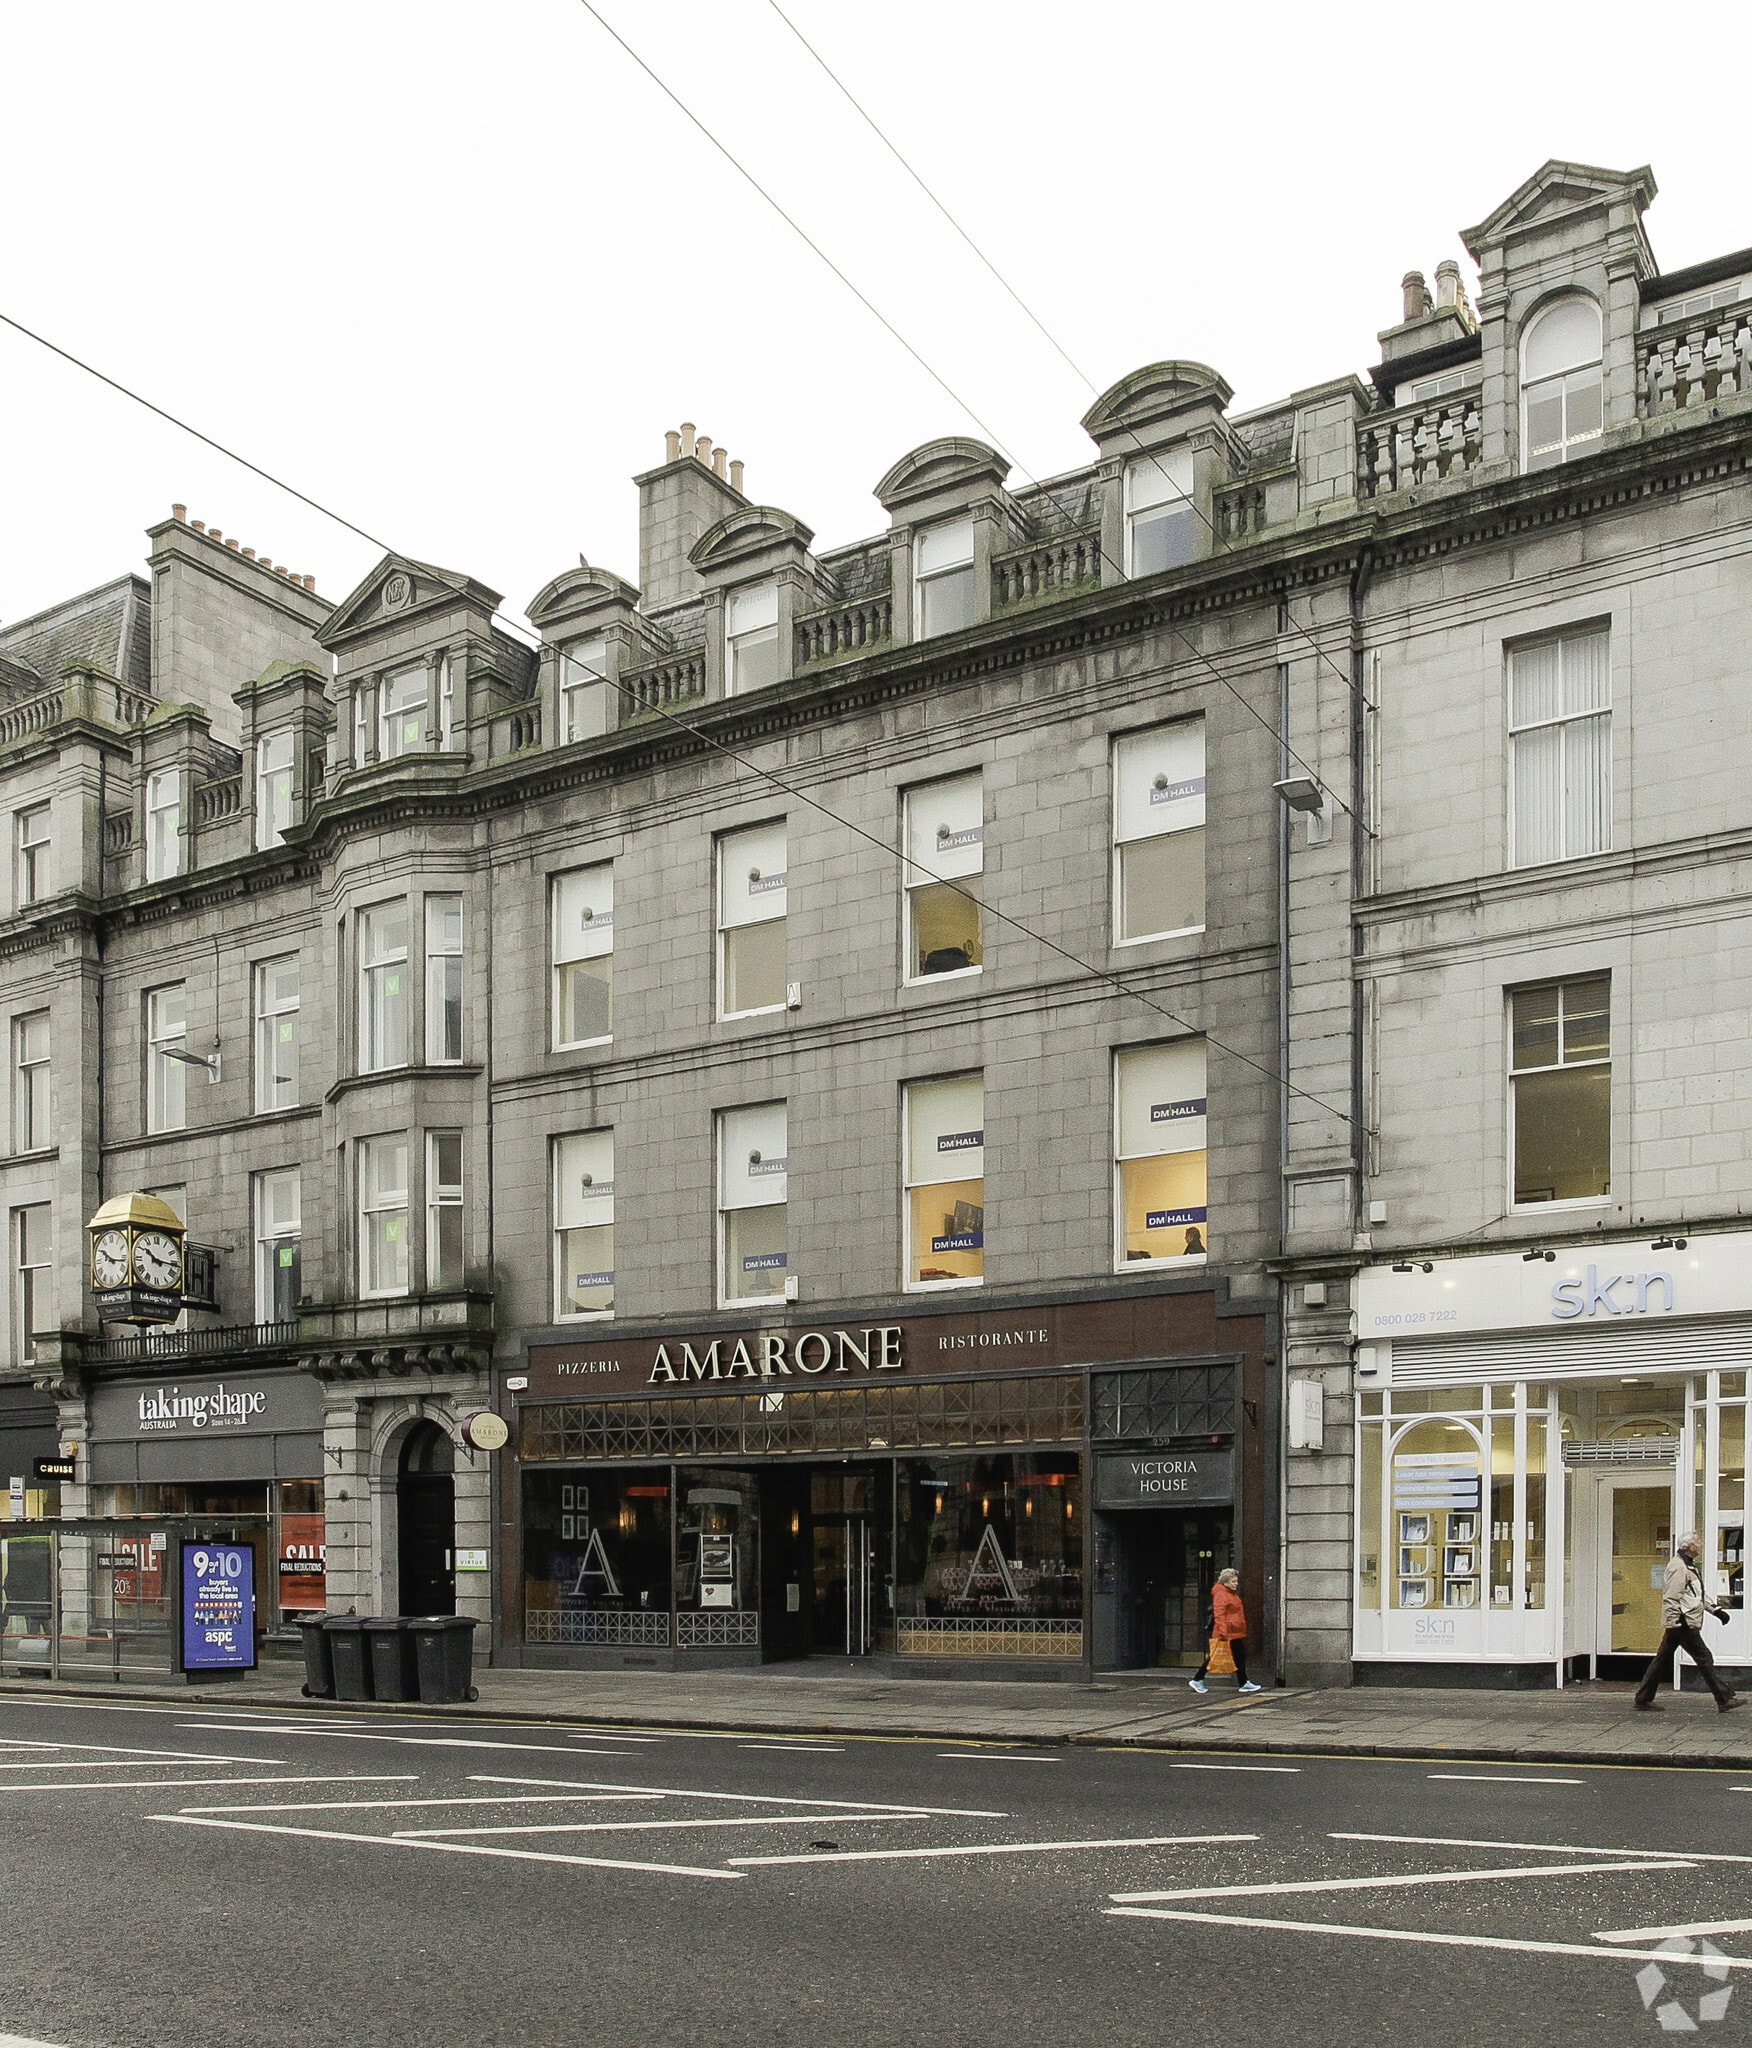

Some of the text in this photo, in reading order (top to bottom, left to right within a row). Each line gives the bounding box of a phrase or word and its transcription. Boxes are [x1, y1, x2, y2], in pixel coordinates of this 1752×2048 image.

[1153, 785, 1196, 801] DM HALL
[939, 834, 978, 849] DM HALL
[751, 878, 786, 892] DM HALL
[1153, 1105, 1197, 1119] DM HALL
[940, 1137, 979, 1149] DM HALL
[750, 1163, 785, 1174] DM HALL
[596, 1185, 614, 1194] HALL
[1149, 1213, 1194, 1226] DM HALL
[934, 1238, 974, 1250] DM HALL
[745, 1259, 780, 1269] DM HALL
[579, 1275, 610, 1286] DM HALL
[1374, 1310, 1457, 1326] 0800 028 7222
[939, 1329, 1048, 1350] RISTORANTE
[647, 1326, 903, 1383] AMARONE
[558, 1360, 621, 1375] PIZZERIA
[139, 1420, 177, 1430] AUSTRALIA
[1152, 1438, 1170, 1447] 259
[40, 1464, 73, 1473] CRUISE
[1131, 1461, 1197, 1475] VICTORIA
[1140, 1479, 1188, 1492] HOUSE
[193, 1551, 209, 1578] 9
[216, 1552, 242, 1578] 10
[281, 1562, 322, 1572] FINAL REDUCTIONS
[199, 1585, 220, 1593] already
[209, 1578, 228, 1587] buyers
[1415, 1615, 1455, 1633] sk:n
[205, 1631, 232, 1646] aspc
